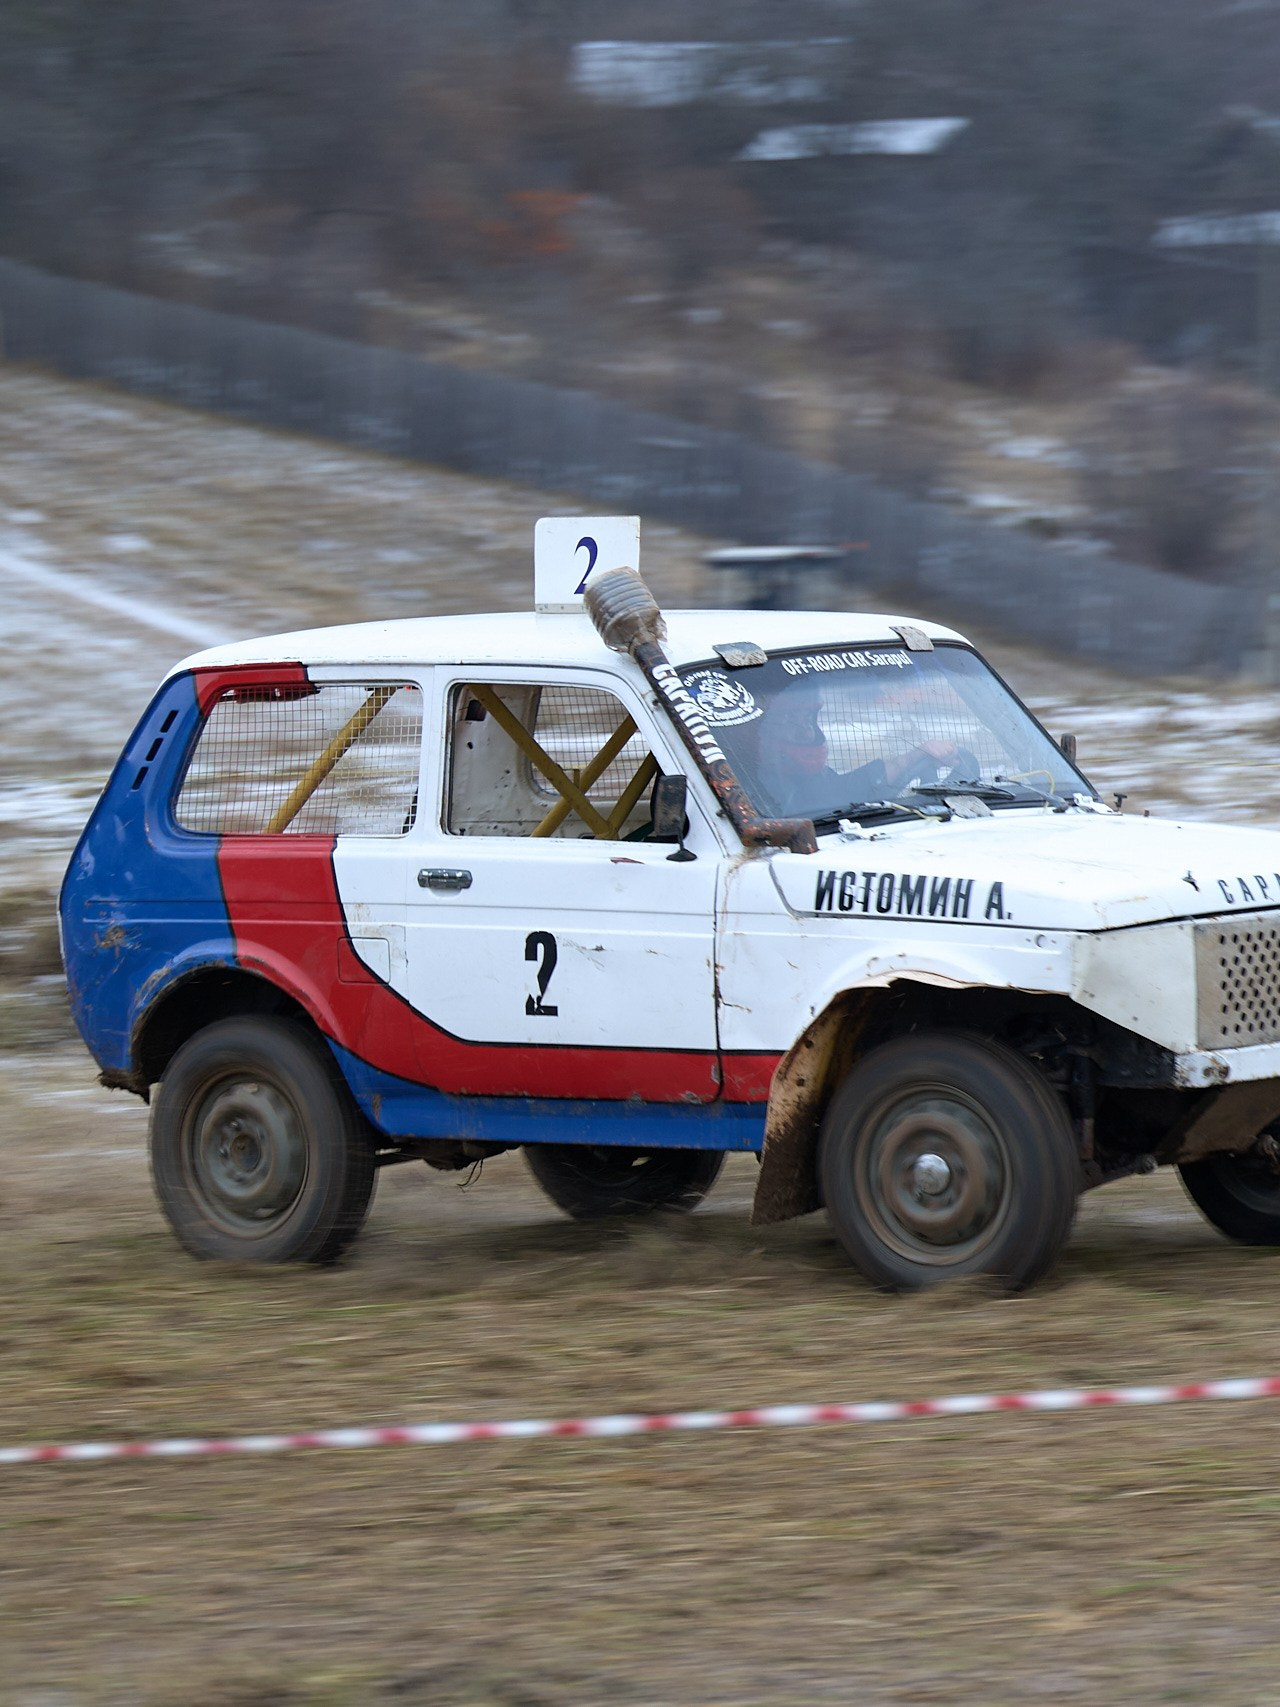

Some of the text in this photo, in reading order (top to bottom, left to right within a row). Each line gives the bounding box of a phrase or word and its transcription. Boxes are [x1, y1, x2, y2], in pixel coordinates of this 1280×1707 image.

[574, 536, 599, 595] 2
[781, 650, 914, 676] OFF-ROAD CAR Sarapul
[815, 870, 1014, 920] ИСТОМИН А.
[524, 930, 559, 1017] 2
